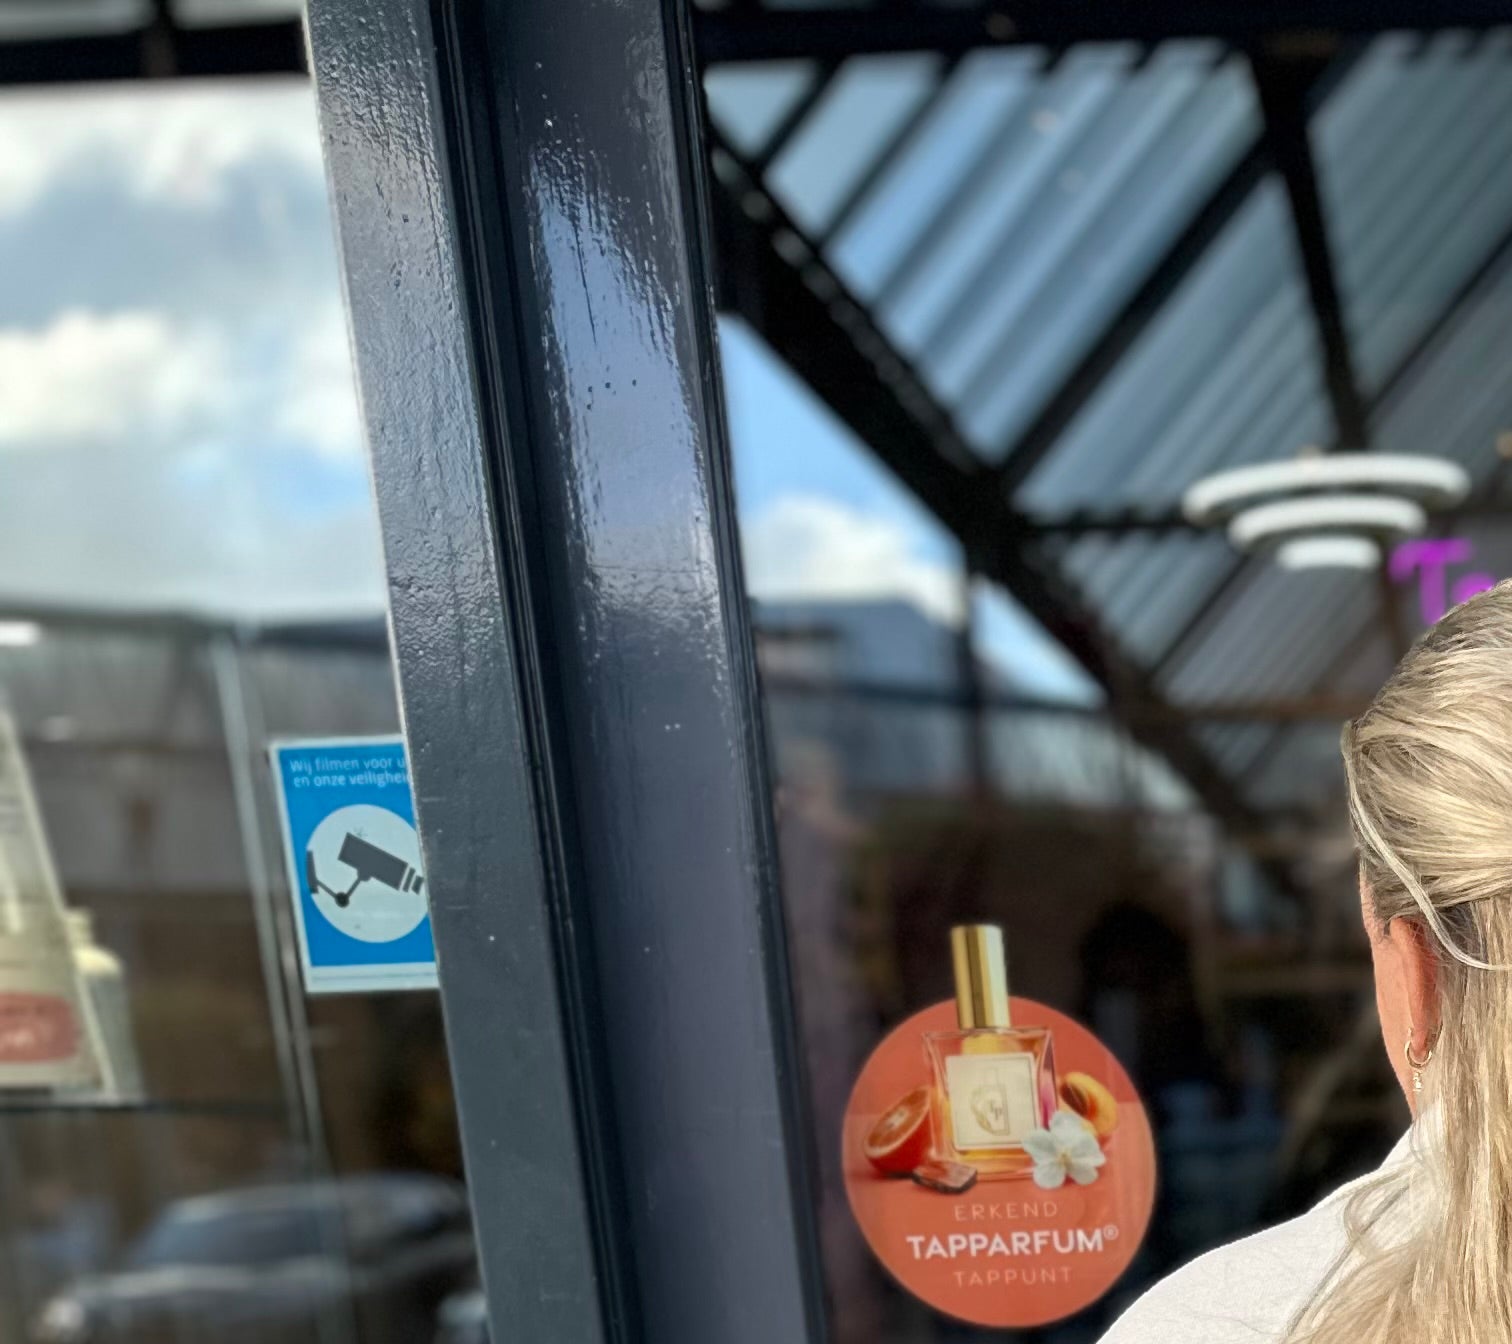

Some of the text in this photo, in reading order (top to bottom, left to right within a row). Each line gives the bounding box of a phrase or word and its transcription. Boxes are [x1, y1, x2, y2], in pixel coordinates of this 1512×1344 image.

[289, 759, 312, 775] Wij
[315, 756, 360, 772] filmen
[363, 757, 392, 770] voor
[293, 770, 411, 788] en onze veilighei
[953, 1201, 1058, 1221] ERKEND
[953, 1267, 1073, 1287] TAPPUNT
